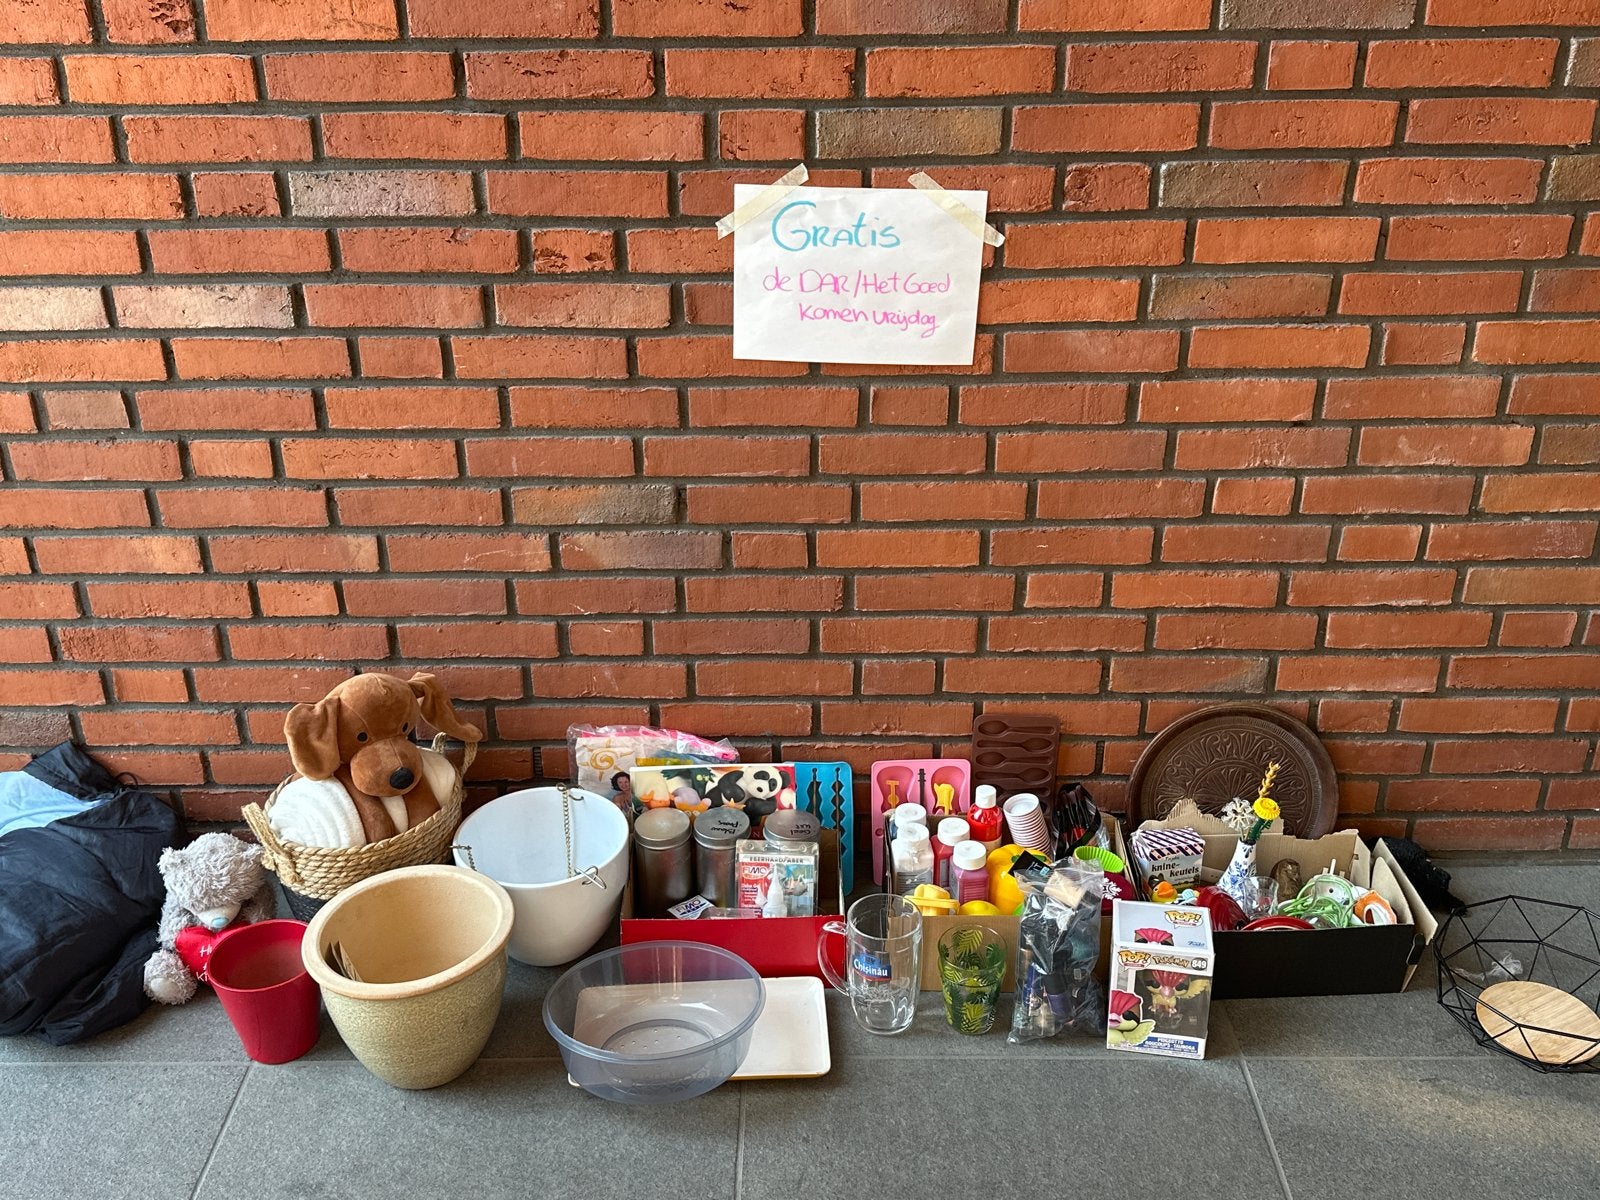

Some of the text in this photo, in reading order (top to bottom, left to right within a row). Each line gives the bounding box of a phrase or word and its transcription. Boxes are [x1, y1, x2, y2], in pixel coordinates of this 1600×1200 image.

[763, 266, 793, 291] de
[903, 272, 951, 295] Goed
[1169, 866, 1199, 877] keutels
[1191, 961, 1207, 969] 849
